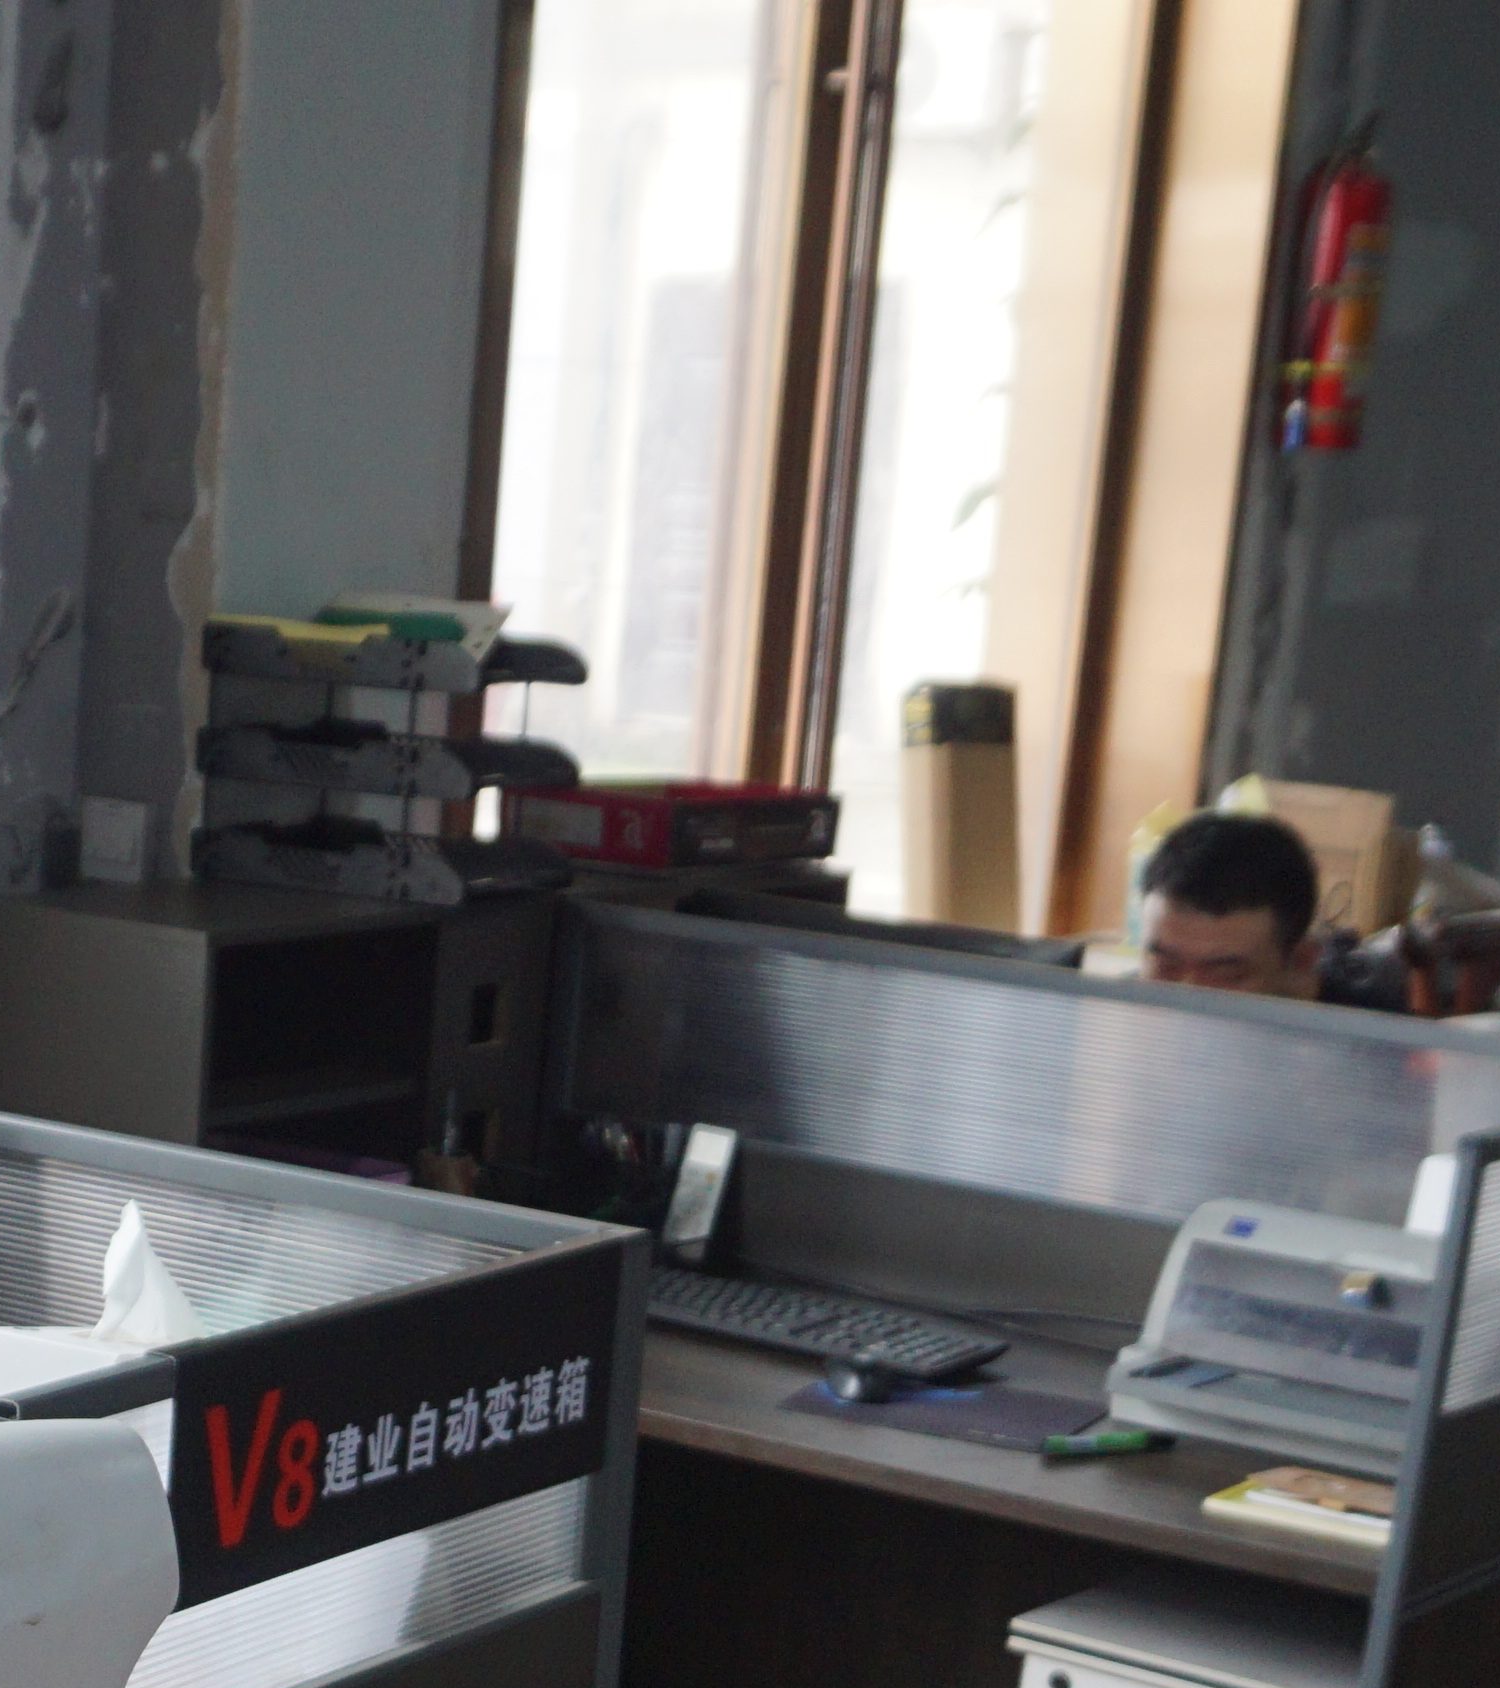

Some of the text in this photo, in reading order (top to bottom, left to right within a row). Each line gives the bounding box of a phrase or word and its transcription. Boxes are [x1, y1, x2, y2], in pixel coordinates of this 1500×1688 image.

[205, 1355, 591, 1547] V8 建业自动变速箱
